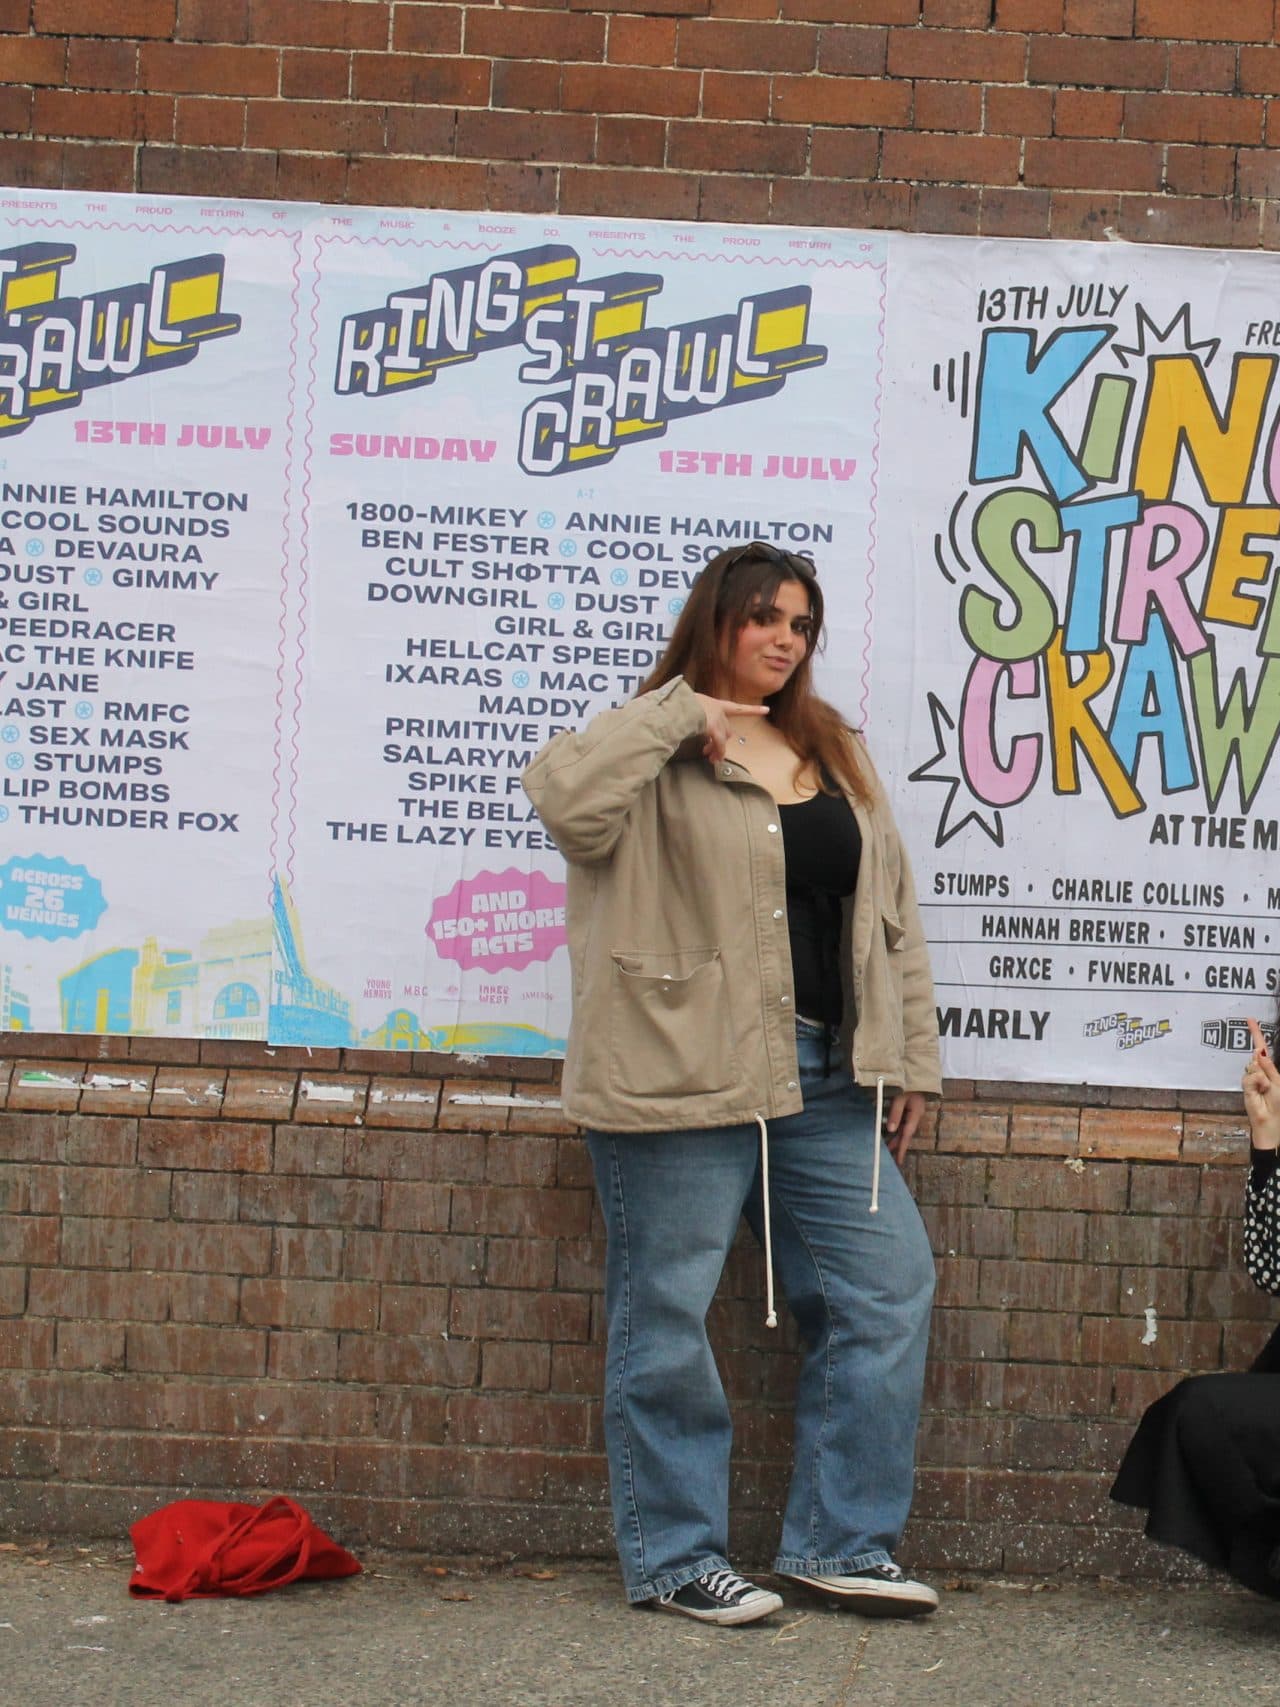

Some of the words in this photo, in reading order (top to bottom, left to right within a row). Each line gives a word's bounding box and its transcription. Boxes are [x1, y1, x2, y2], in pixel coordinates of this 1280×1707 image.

[331, 218, 352, 226] THE
[380, 220, 415, 229] MUSIC
[478, 224, 516, 235] BOOZE
[673, 234, 696, 243] THE
[722, 237, 761, 246] PROUD
[789, 240, 832, 250] RETURN
[859, 243, 874, 252] OF
[977, 286, 1049, 322] 13TH
[1057, 284, 1128, 318] JULY
[338, 260, 522, 393] KING
[521, 301, 769, 473] CRAWL
[75, 420, 166, 445] 13TH
[177, 425, 271, 450] JULY
[330, 433, 496, 462] SUNDAY
[659, 450, 752, 476] 13TH
[763, 455, 857, 481] JULY
[86, 487, 248, 511] HAMILTON
[1, 510, 89, 532] COOL
[97, 514, 230, 537] SOUNDS
[346, 502, 528, 528] 1800-MIKEY
[565, 512, 661, 534] ANNIE
[670, 517, 833, 543] HAMILTON
[55, 539, 203, 563] DEVAURA
[361, 529, 423, 550] BEN
[433, 532, 549, 556] FESTER
[587, 540, 673, 562] COOL
[112, 568, 219, 590] GIMMY
[18, 591, 89, 612] GIRL
[368, 583, 537, 609] DOWNGIRL
[575, 592, 659, 615] DUST
[495, 615, 564, 637] GIRL
[573, 619, 593, 638] &
[603, 622, 672, 642] GIRL
[34, 645, 95, 665] THE
[104, 649, 194, 670] KNIFE
[407, 638, 545, 662] HELLCAT
[15, 672, 99, 692] JANE
[386, 664, 503, 688] IXARAS
[539, 671, 608, 693] MAC
[104, 702, 190, 723] RMFC
[479, 695, 591, 718] MADDY
[29, 725, 90, 746] SEX
[100, 729, 190, 750] MASK
[386, 717, 538, 742] PRIMITIVE
[34, 752, 163, 776] STUMPS
[4, 778, 50, 797] LIP
[59, 780, 170, 802] BOMBS
[408, 771, 496, 794] SPIKE
[18, 805, 169, 830] THUNDER
[178, 812, 239, 832] FOX
[1150, 814, 1184, 845] AT
[1191, 815, 1246, 849] THE
[326, 821, 387, 842] THE
[397, 825, 475, 847] LAZY
[11, 868, 83, 890] ACROSS
[934, 872, 1009, 897] STUMPS
[1052, 878, 1133, 903] CHARLIE
[1143, 882, 1224, 907] COLLINS
[24, 886, 65, 912] 26
[472, 890, 526, 913] AND
[7, 905, 79, 928] VENUES
[432, 919, 488, 940] 150+
[494, 907, 566, 933] MORE
[472, 932, 533, 957] ACTS
[982, 915, 1060, 940] HANNAH
[1069, 919, 1149, 944] BREWER
[1184, 924, 1255, 949] STEVAN
[990, 955, 1052, 980] GRXCE
[1088, 961, 1174, 985] FVNERAL
[1205, 966, 1256, 990] GENA
[936, 1007, 1050, 1040] MARLY
